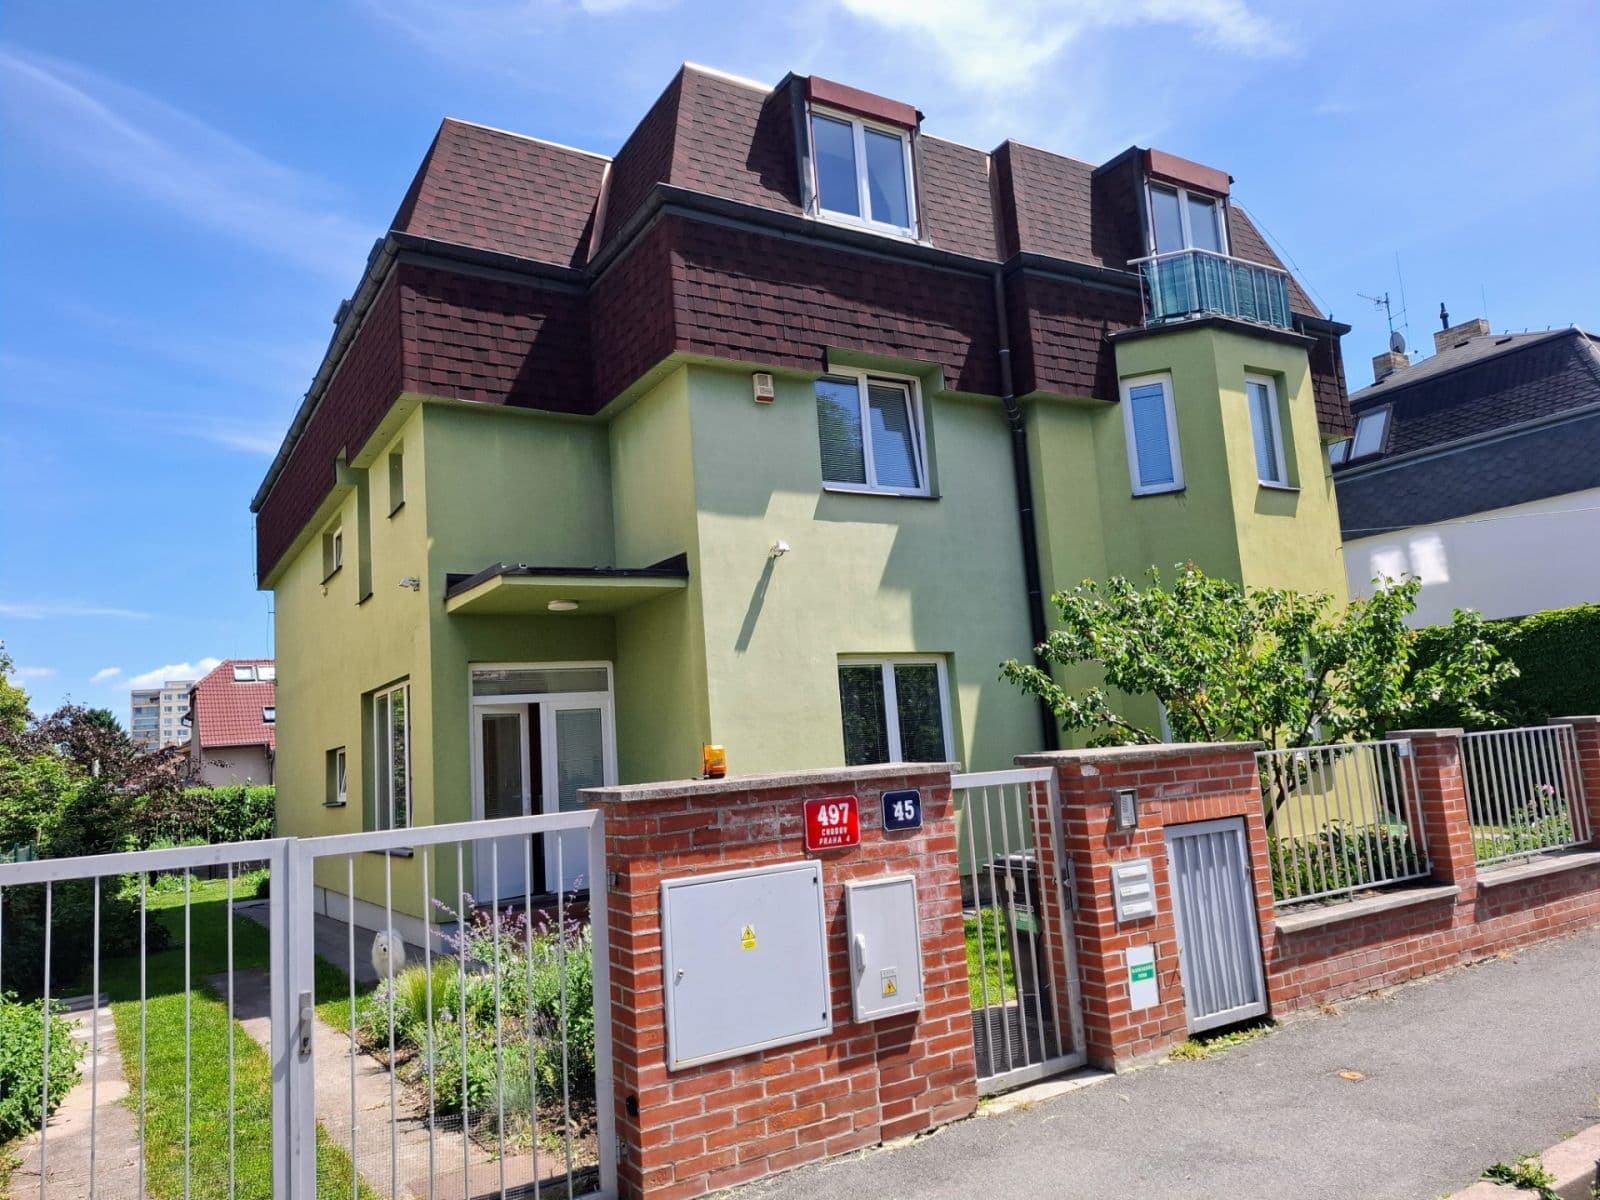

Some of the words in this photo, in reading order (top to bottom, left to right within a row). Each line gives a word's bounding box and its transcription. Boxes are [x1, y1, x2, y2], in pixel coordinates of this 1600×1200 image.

[817, 803, 849, 826] 497
[894, 799, 915, 821] 45
[819, 836, 842, 845] PRAHA
